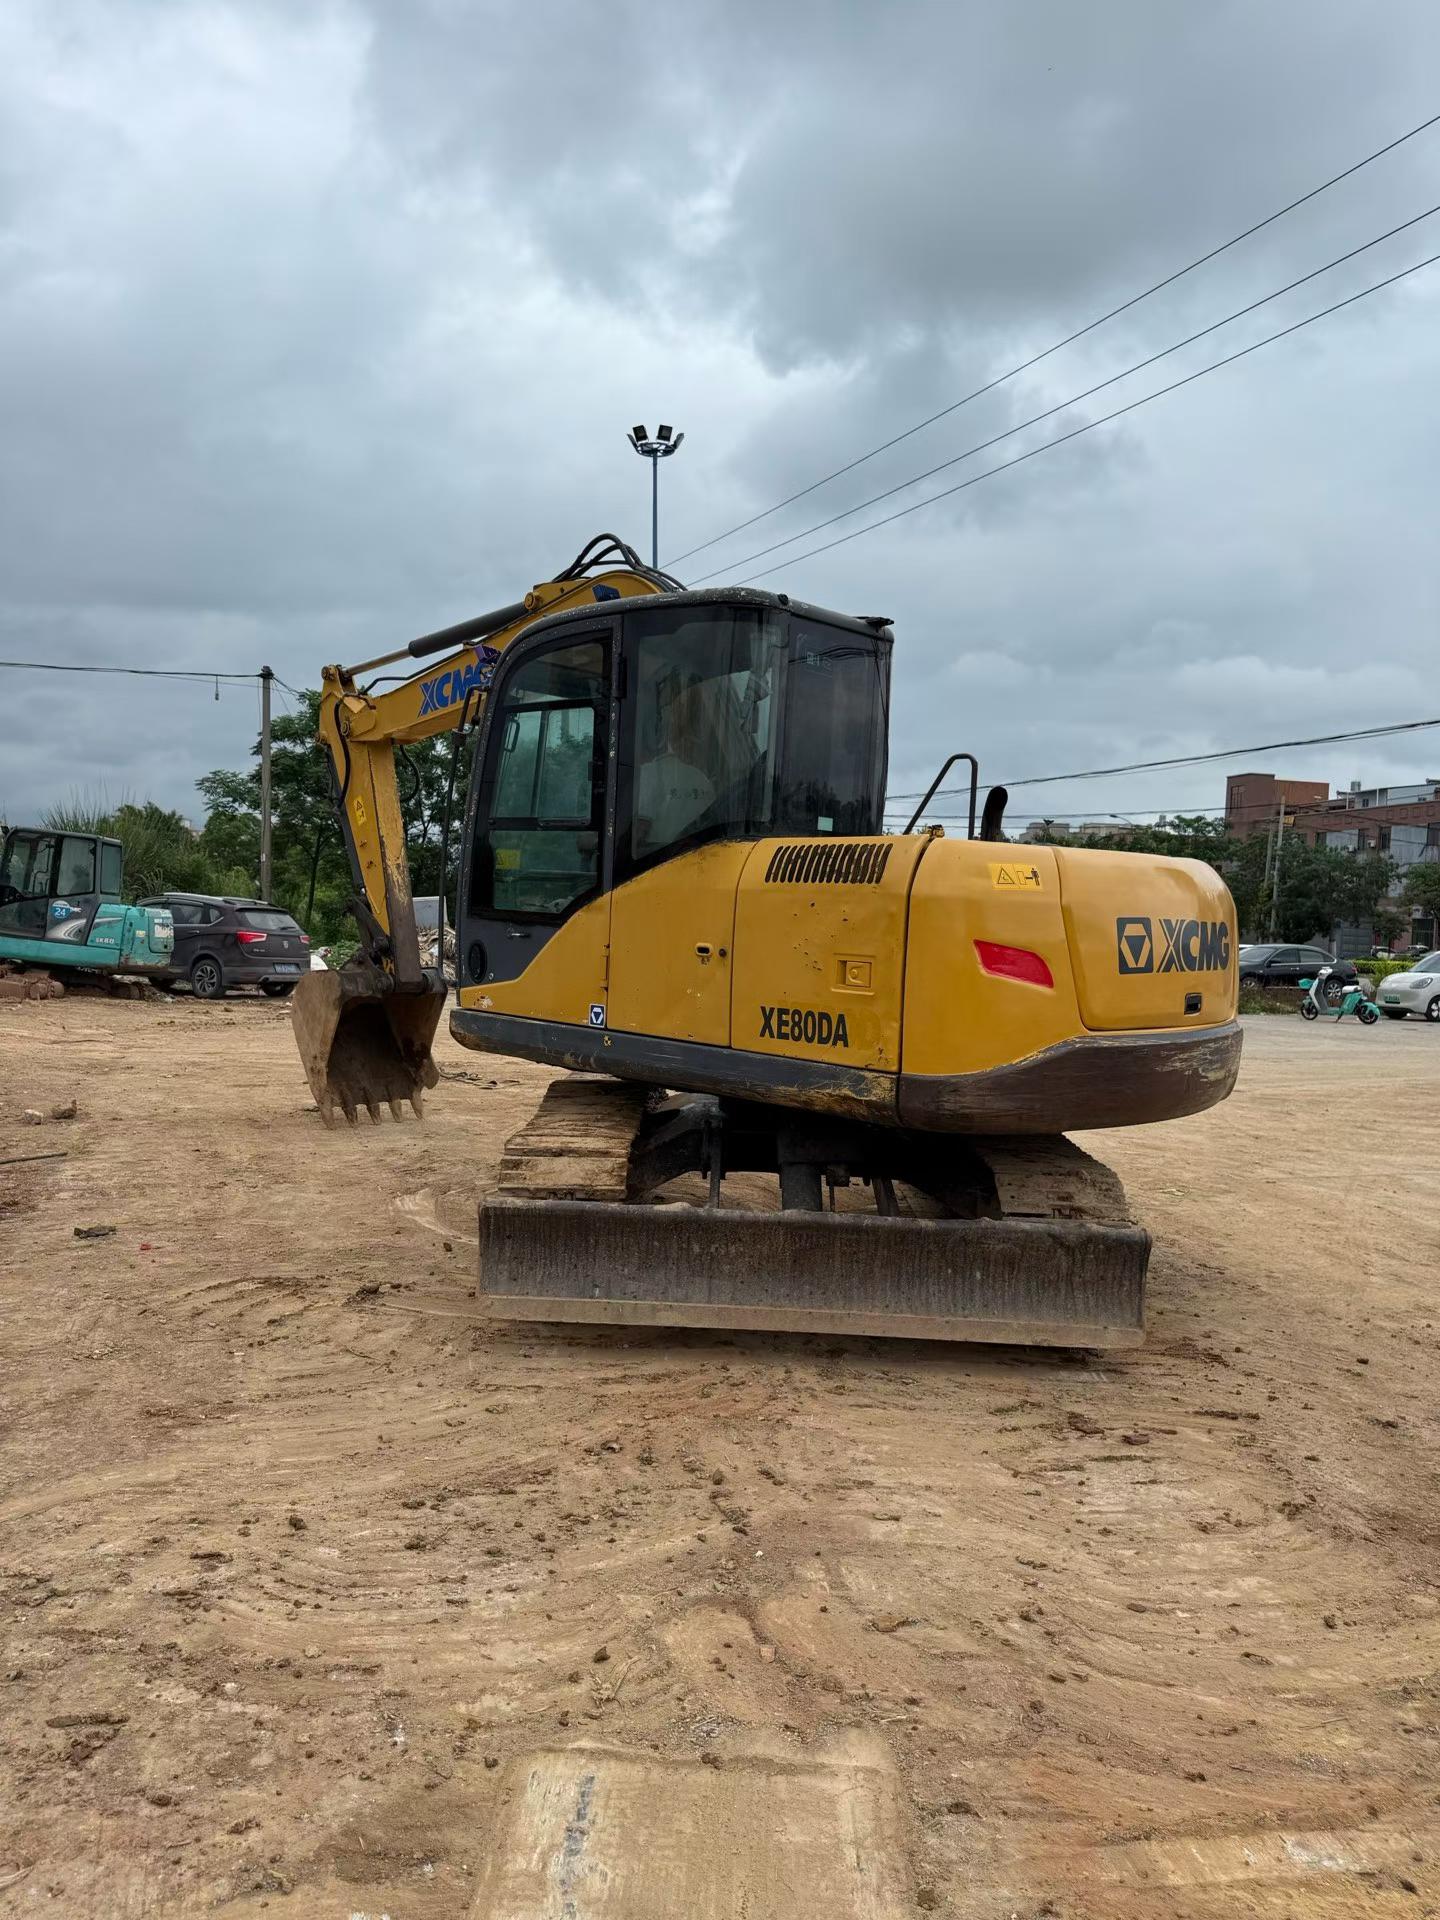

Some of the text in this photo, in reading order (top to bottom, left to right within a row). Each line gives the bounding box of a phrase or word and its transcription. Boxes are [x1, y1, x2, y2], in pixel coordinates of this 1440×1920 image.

[55, 907, 66, 917] 24
[1156, 919, 1230, 973] XCMG
[759, 1005, 849, 1048] XE80DA
